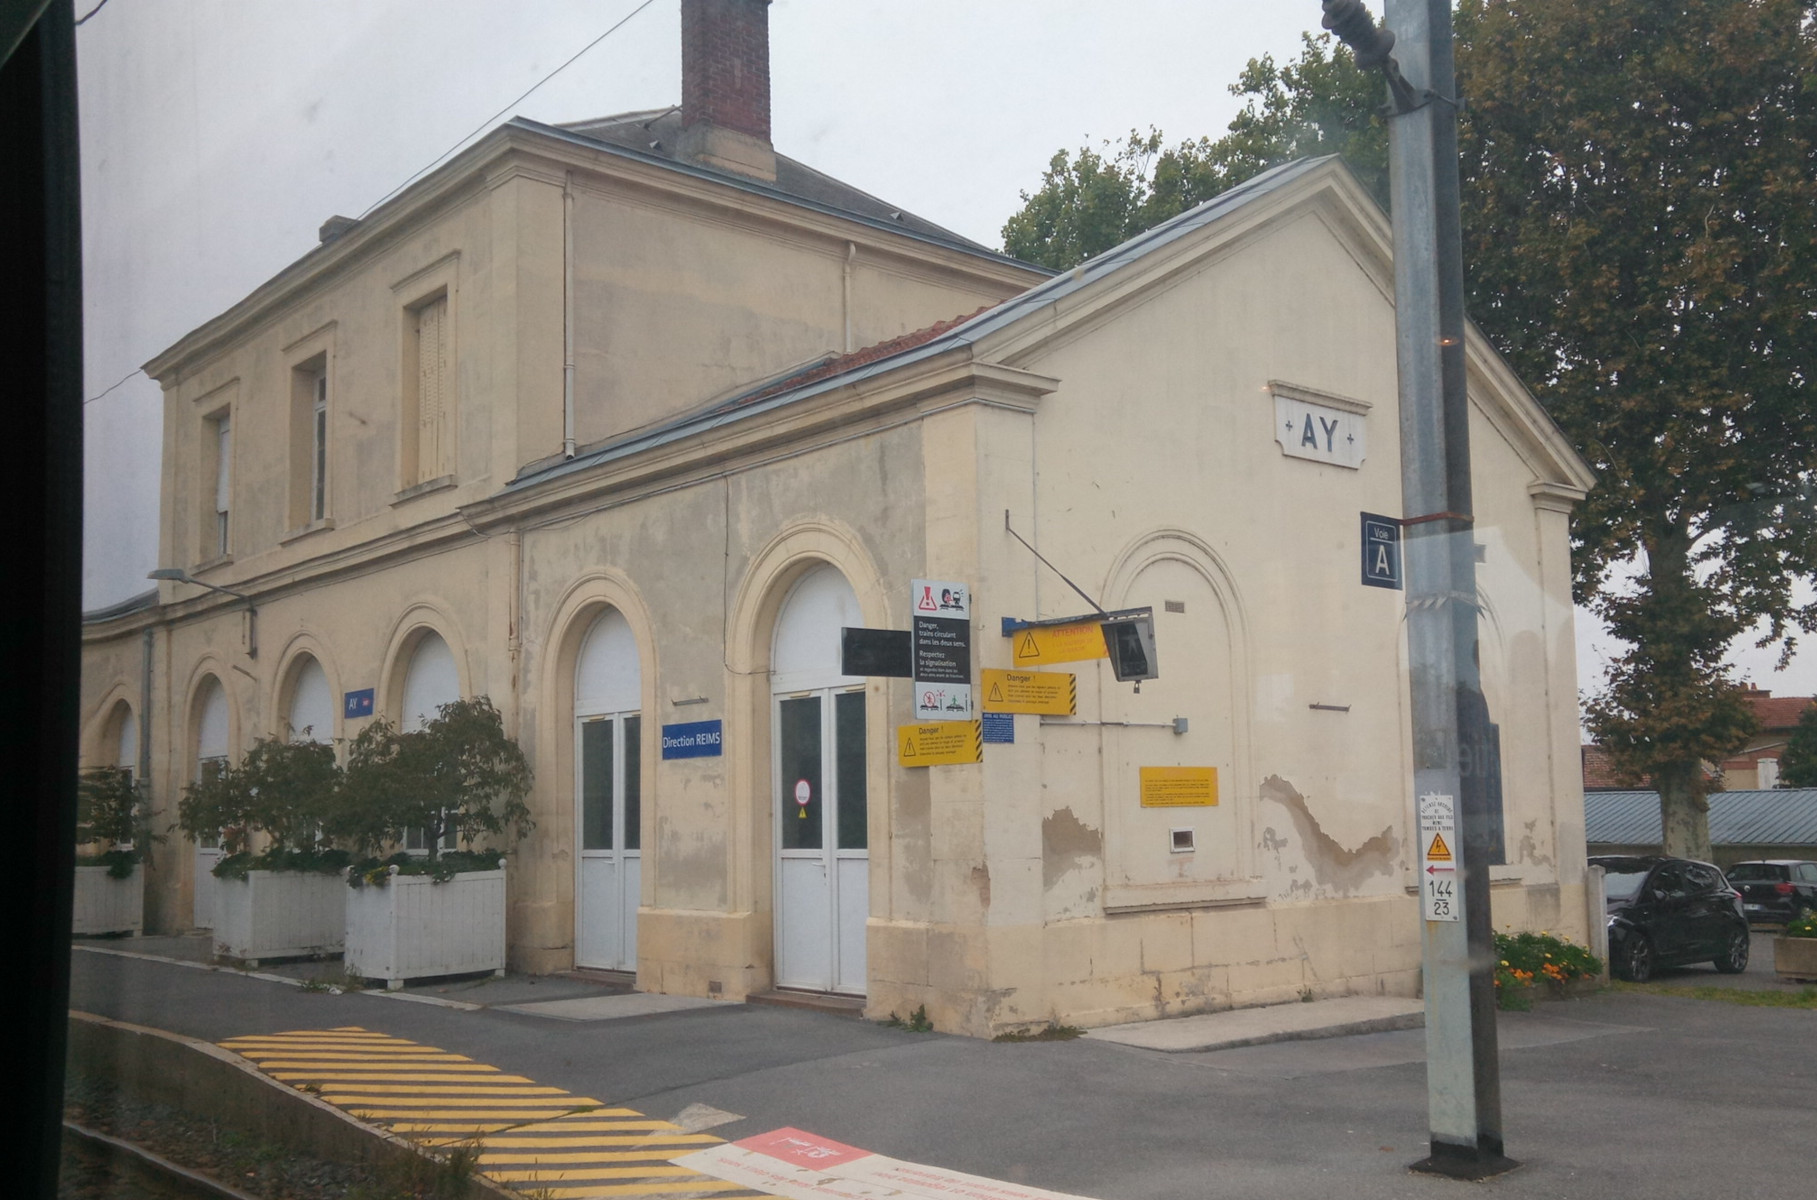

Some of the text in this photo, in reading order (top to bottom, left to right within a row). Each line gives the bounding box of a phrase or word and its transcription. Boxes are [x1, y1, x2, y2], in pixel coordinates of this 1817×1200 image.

[1301, 412, 1339, 452] AY
[1374, 527, 1389, 539] Voie
[1375, 545, 1390, 575] A
[918, 621, 939, 630] Danger,
[1052, 625, 1093, 638] ATTENTION
[919, 650, 945, 658] Respectez
[925, 659, 956, 667] signalisation
[1006, 673, 1031, 683] Danger
[348, 697, 358, 710] AY
[919, 727, 939, 735] Danger
[663, 732, 721, 748] Direction REIMS
[1429, 880, 1453, 897] 144
[1434, 902, 1450, 916] 23
